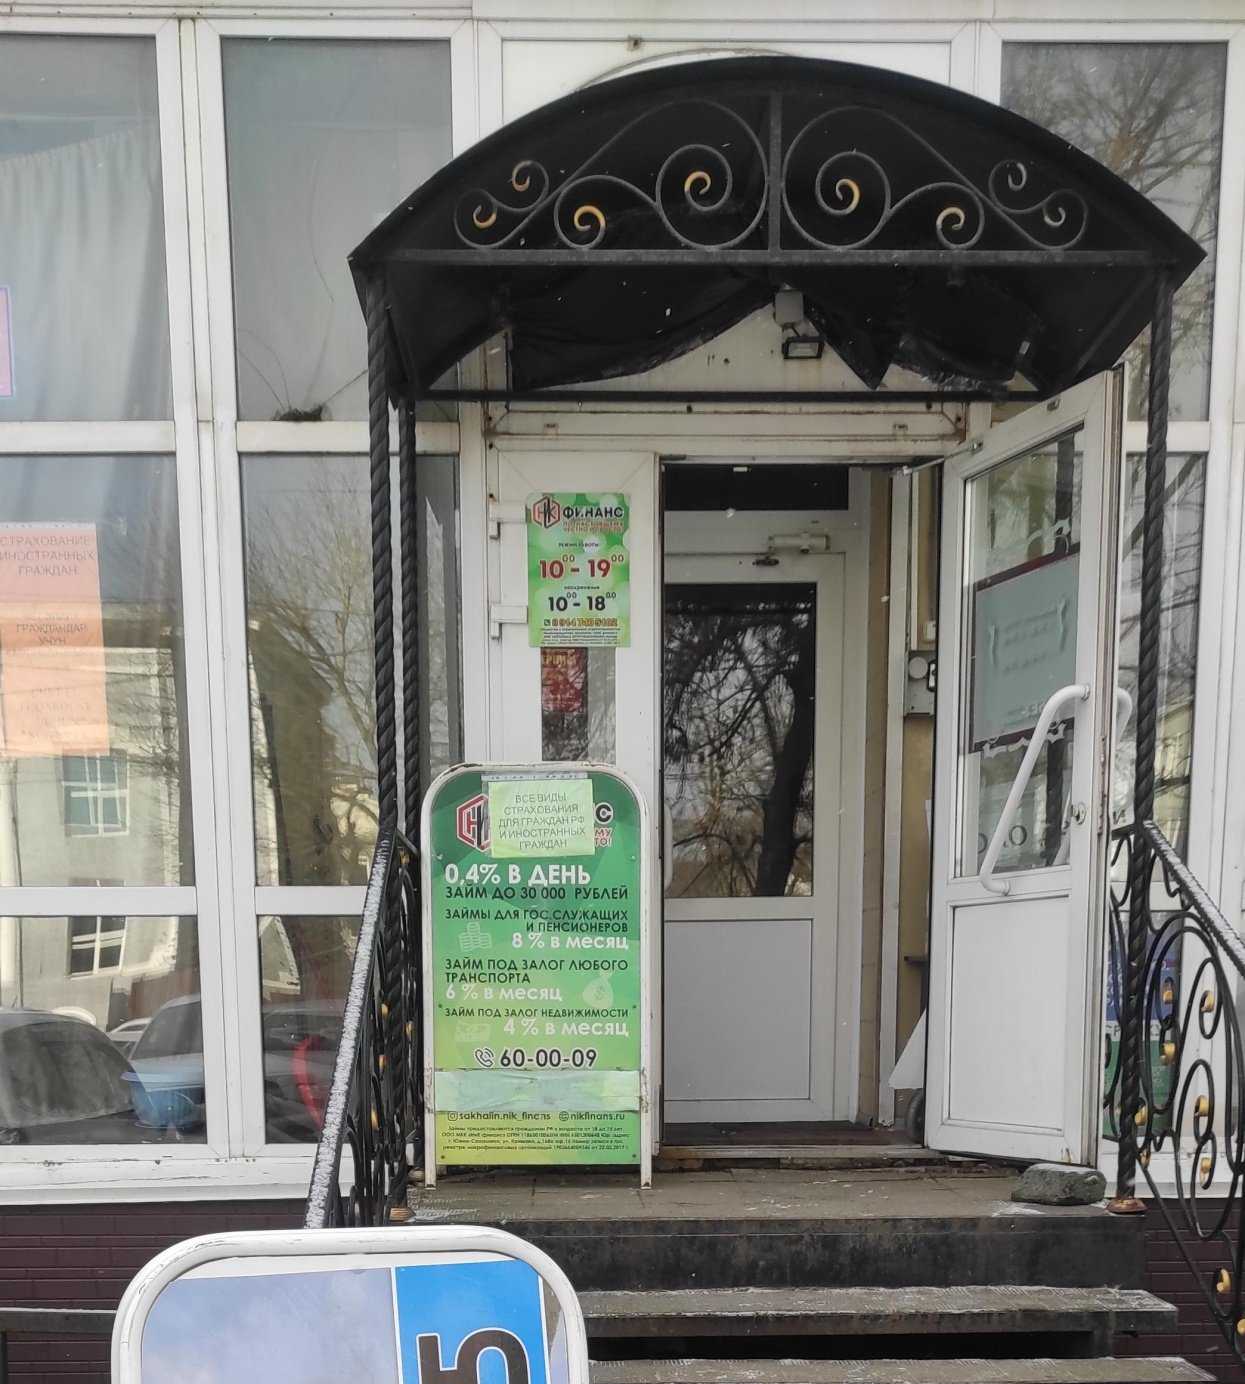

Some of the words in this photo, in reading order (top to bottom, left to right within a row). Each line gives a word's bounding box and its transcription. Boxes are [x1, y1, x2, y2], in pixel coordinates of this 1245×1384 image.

[562, 506, 623, 519] ФИНАНС
[539, 560, 564, 579] 10
[587, 559, 611, 577] 19
[548, 596, 568, 611] 10
[587, 596, 606, 611] 18
[515, 793, 535, 802] ВСЕ
[535, 792, 567, 802] ВИДЫ
[504, 804, 578, 816] СТРАХОВАНИЯ
[499, 818, 520, 829] ДЛЯ
[521, 817, 570, 829] ГРАЖДАН
[570, 816, 585, 825] РФ
[500, 830, 507, 839] И
[508, 828, 586, 838] ИНОСТРАННЫХ
[519, 839, 567, 850] ГРАЖДАН
[445, 864, 500, 886] 0,4%
[508, 865, 521, 884] В
[528, 865, 591, 886] ДЕНЬ
[446, 884, 488, 899] ЗАЙМ
[492, 887, 515, 900] ДО
[520, 887, 538, 899] 30
[540, 887, 566, 899] 000
[575, 885, 629, 899] РУБЛЕЙ
[445, 907, 490, 920] ЗАЙМЫ
[495, 909, 519, 921] ДЛЯ
[526, 922, 534, 931] И
[538, 922, 628, 933] ПЕНСИОНЕРОВ
[512, 932, 523, 948] 8
[528, 932, 545, 949] %
[551, 936, 560, 948] в
[566, 935, 629, 950] месяц
[445, 956, 483, 970] ЗАЙМ
[488, 959, 518, 971] ПОД
[522, 959, 565, 970] ЗАЛОГ
[569, 959, 628, 971] ЛЮБОГО
[446, 972, 531, 984] ТРАНСПОРТА
[446, 984, 456, 999] 6
[462, 984, 478, 1000] %
[484, 988, 493, 999] в
[500, 987, 562, 1001] месяц
[445, 1007, 474, 1017] ЗАЙМ
[478, 1008, 501, 1017] ПОД
[504, 1008, 538, 1017] ЗАЛОГ
[541, 1008, 629, 1018] НЕДВИЖИМОСТИ
[504, 1019, 514, 1035] 4
[521, 1019, 538, 1036] %
[545, 1022, 555, 1035] в
[561, 1021, 630, 1037] месяц
[500, 1049, 597, 1068] 60-00-09
